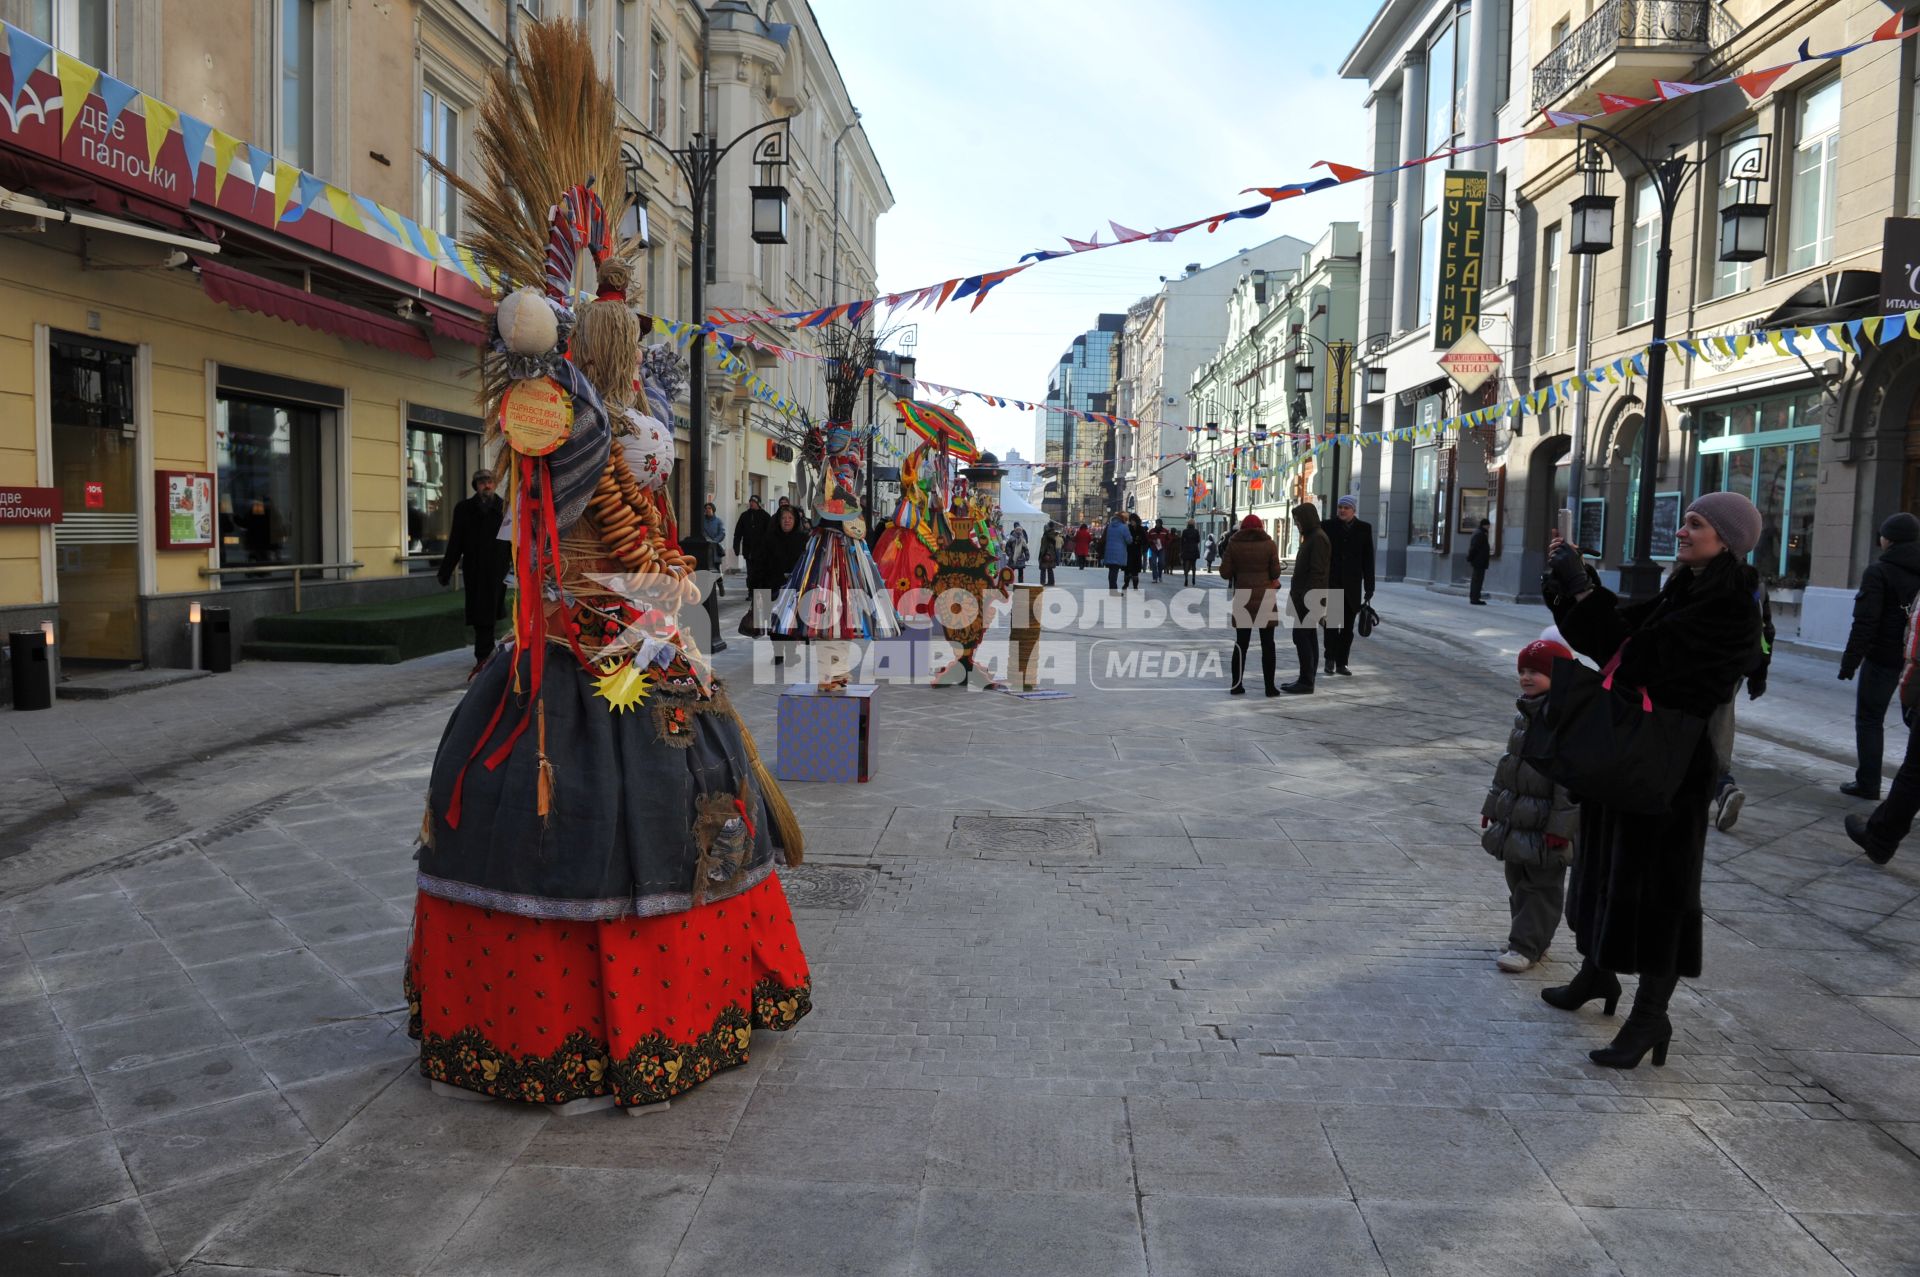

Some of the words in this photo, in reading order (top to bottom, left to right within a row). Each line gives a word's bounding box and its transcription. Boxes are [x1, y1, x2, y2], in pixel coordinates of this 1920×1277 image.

[82, 136, 176, 191] палочки
[1442, 200, 1459, 341] УЧЕБНЫЙ
[1453, 364, 1489, 372] КНИГА
[86, 485, 102, 494] -10%
[0, 507, 52, 518] палочки
